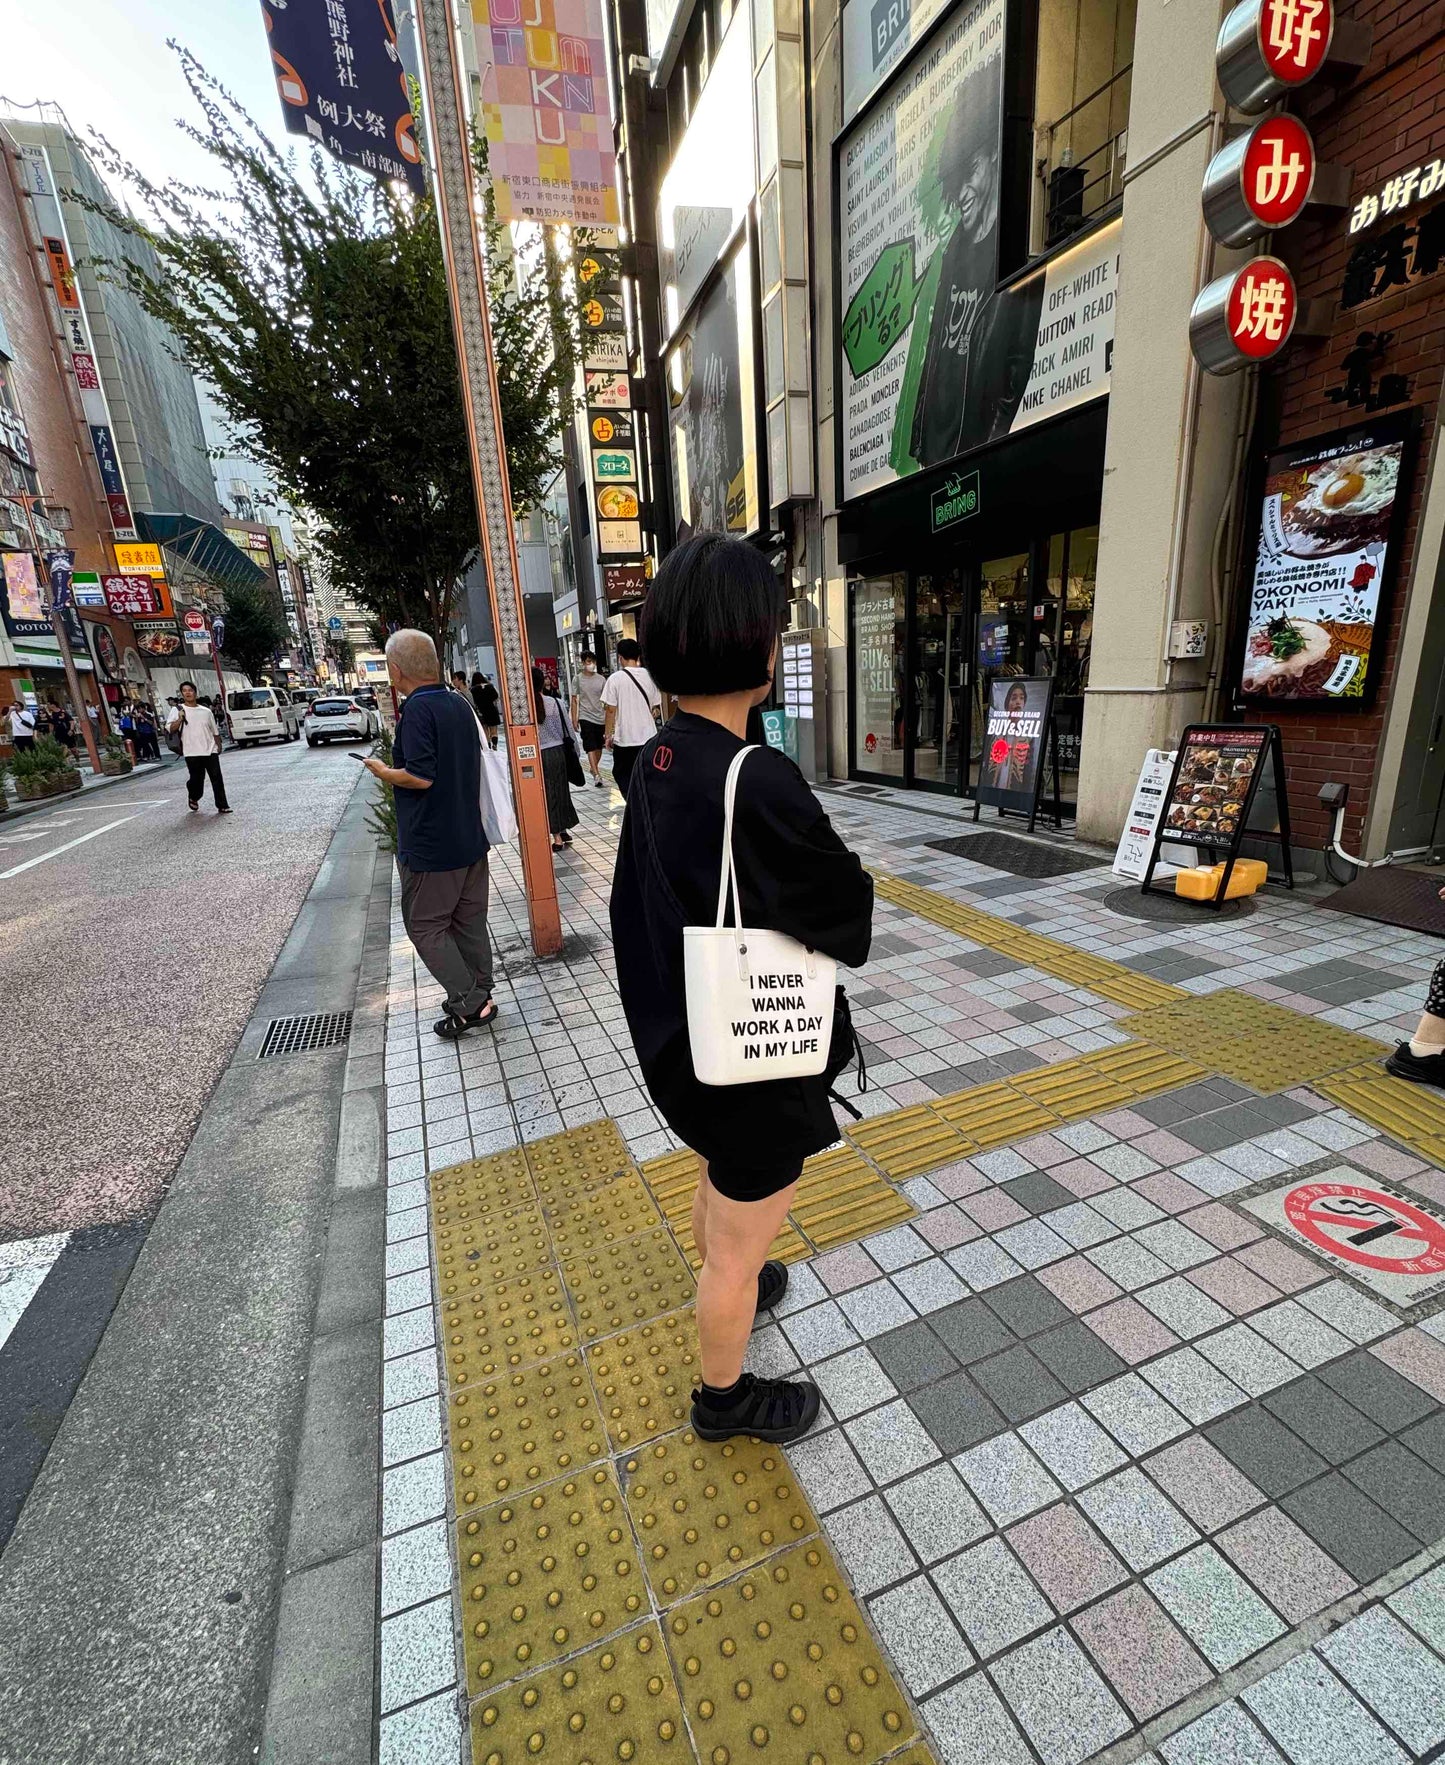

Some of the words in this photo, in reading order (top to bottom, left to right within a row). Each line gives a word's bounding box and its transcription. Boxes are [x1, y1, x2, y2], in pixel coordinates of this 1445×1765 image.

[863, 138, 889, 172] MAISON
[890, 96, 925, 145] MARGIELA
[929, 42, 975, 105] BURBERRY
[979, 11, 1002, 51] DIOR
[868, 114, 885, 143] FEAR
[915, 48, 941, 90] CELINE
[316, 94, 387, 139] 例大祭
[847, 187, 864, 215] SAINT
[865, 157, 894, 197] LAURENT
[895, 134, 916, 168] PARIS
[1255, 138, 1305, 205] み
[536, 207, 597, 220] 防犯カメラ作動中
[847, 211, 868, 239] VISVIM
[891, 167, 914, 197] MARIA
[853, 251, 880, 283] BATHING
[1048, 261, 1109, 312] OFF-WHITE
[1233, 275, 1288, 341] 焼
[590, 344, 623, 357] IRIKA
[1061, 333, 1095, 366] AMIRI
[849, 373, 870, 399] ADIDAS
[1022, 387, 1045, 413] NIKE
[1050, 366, 1092, 400] CHANEL
[849, 397, 868, 420] PRADA
[871, 378, 900, 406] MONCLER
[596, 418, 611, 440] 占
[849, 406, 891, 441] CANADAGOOSE
[97, 428, 116, 473] 大戸屋
[849, 433, 884, 462] BALENCIAGA
[600, 461, 629, 471] マローネ
[849, 461, 870, 482] COMME
[870, 457, 879, 473] DE
[935, 490, 976, 526] BRING
[121, 550, 158, 563] 鳥貴族
[105, 576, 149, 593] 銀だこ
[606, 578, 644, 589] らーめん
[1254, 578, 1346, 599] OKONOMI
[108, 593, 153, 602] ハイボール
[124, 601, 154, 613] 横丁
[860, 597, 896, 614] ブランド古着
[1253, 597, 1295, 612] YAKI
[860, 614, 881, 625] SECOND
[880, 612, 896, 623] HAND
[860, 625, 879, 634] BRAND
[880, 622, 896, 632] SHOP
[860, 648, 890, 671] BUY&
[869, 670, 896, 692] SELL
[987, 718, 1041, 737] BUY&SELL
[1058, 734, 1081, 746] 定番も
[750, 975, 754, 989] I
[758, 974, 804, 989] NEVER
[751, 996, 806, 1012] WANNA
[731, 1020, 780, 1037] WORK
[784, 1019, 794, 1033] A
[797, 1016, 823, 1032] DAY
[744, 1044, 760, 1059] IN
[765, 1042, 788, 1058] MY
[792, 1038, 818, 1055] LIFE
